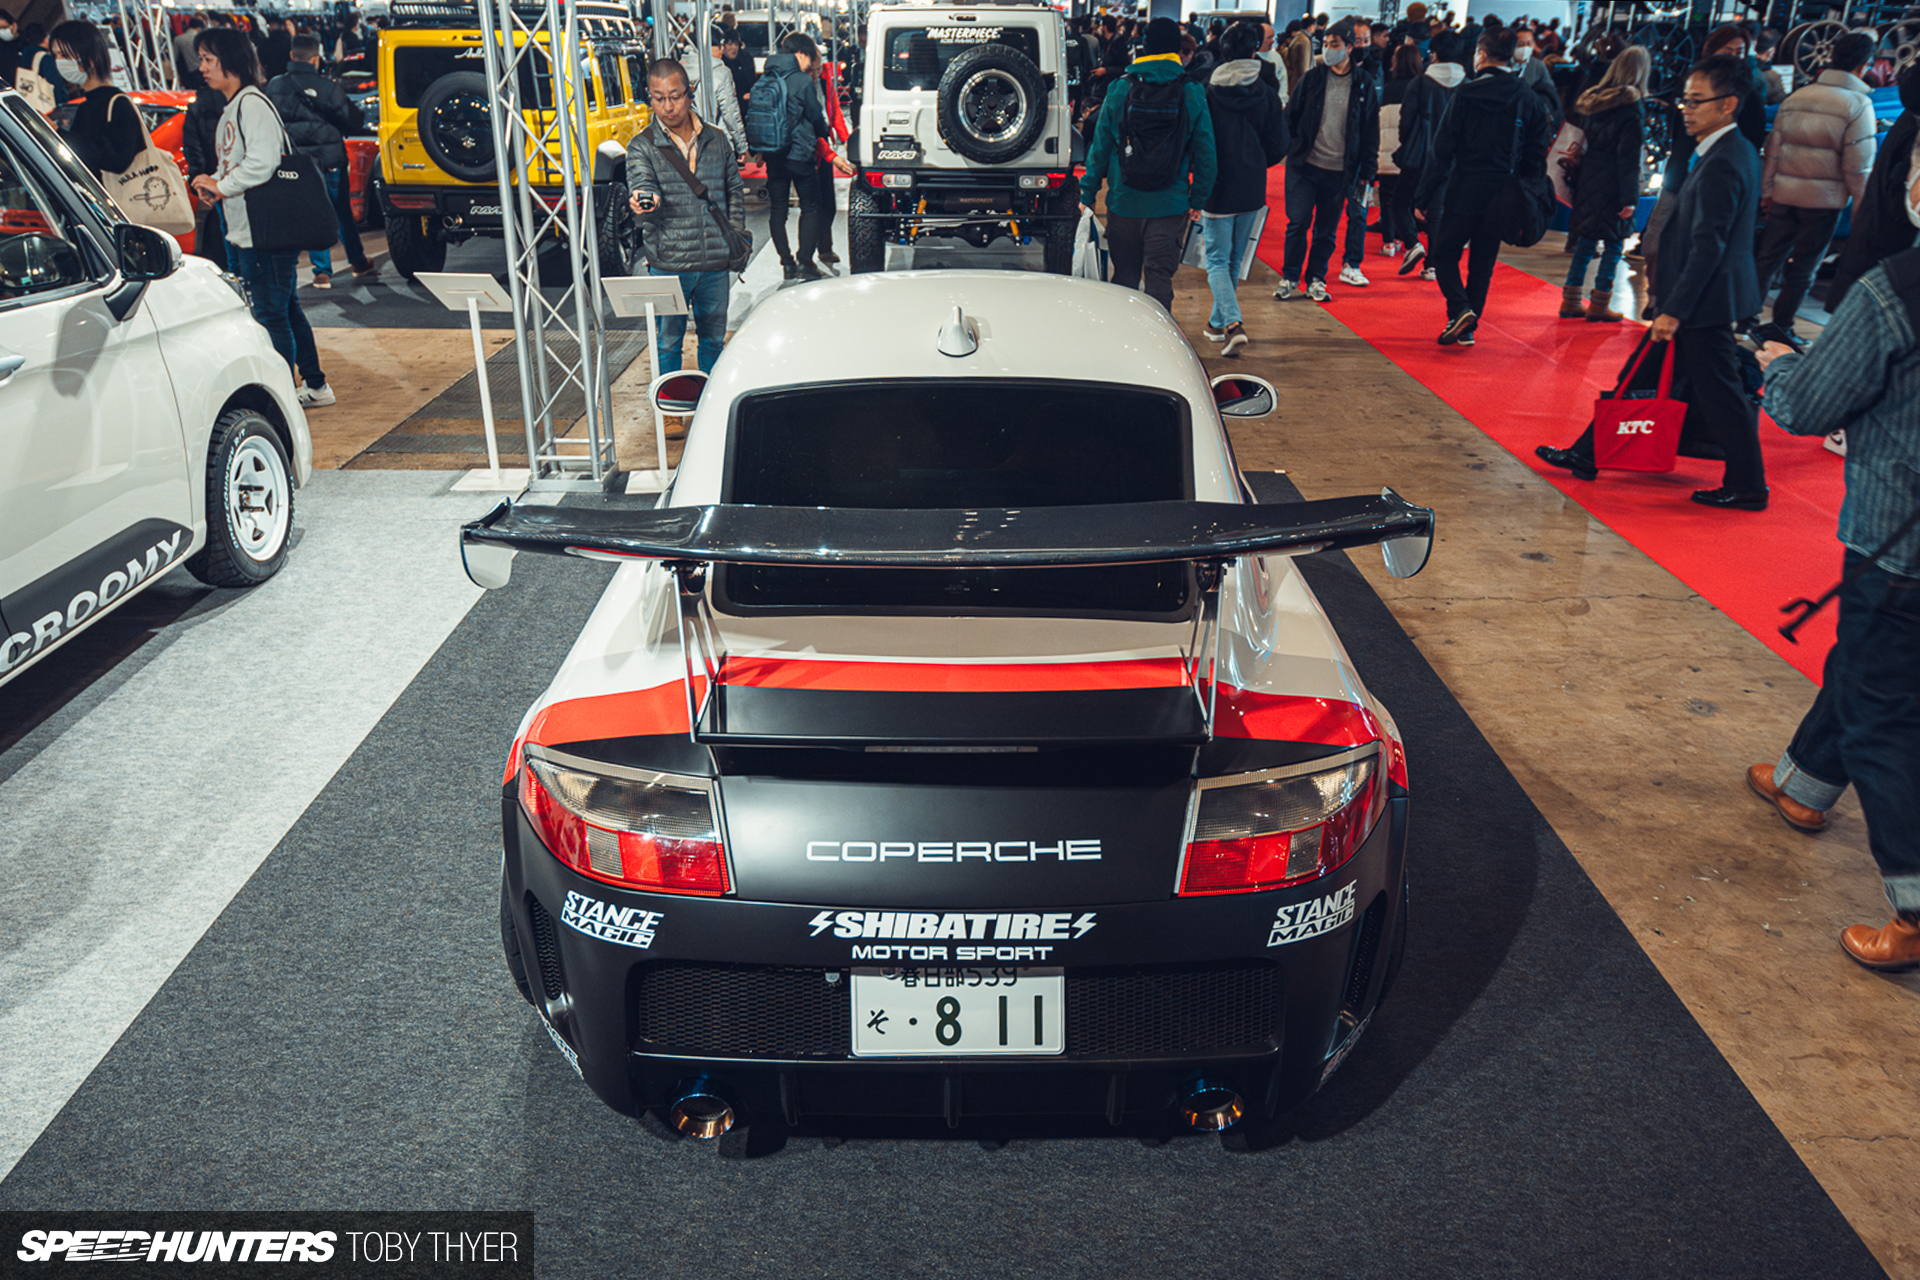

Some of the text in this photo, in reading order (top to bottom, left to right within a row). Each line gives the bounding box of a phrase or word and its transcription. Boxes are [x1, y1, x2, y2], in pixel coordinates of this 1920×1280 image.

[877, 150, 917, 159] RAYS
[1617, 420, 1655, 434] KTC
[0, 529, 182, 673] CROOMY
[806, 839, 1102, 863] COPERCHE
[563, 890, 665, 933] STANCE
[1272, 879, 1357, 929] STANCE
[561, 908, 655, 946] MAGIC
[833, 911, 1073, 940] SHIBATIRE
[1268, 903, 1354, 945] MAGIC
[851, 945, 1053, 960] MOTOR SPORT
